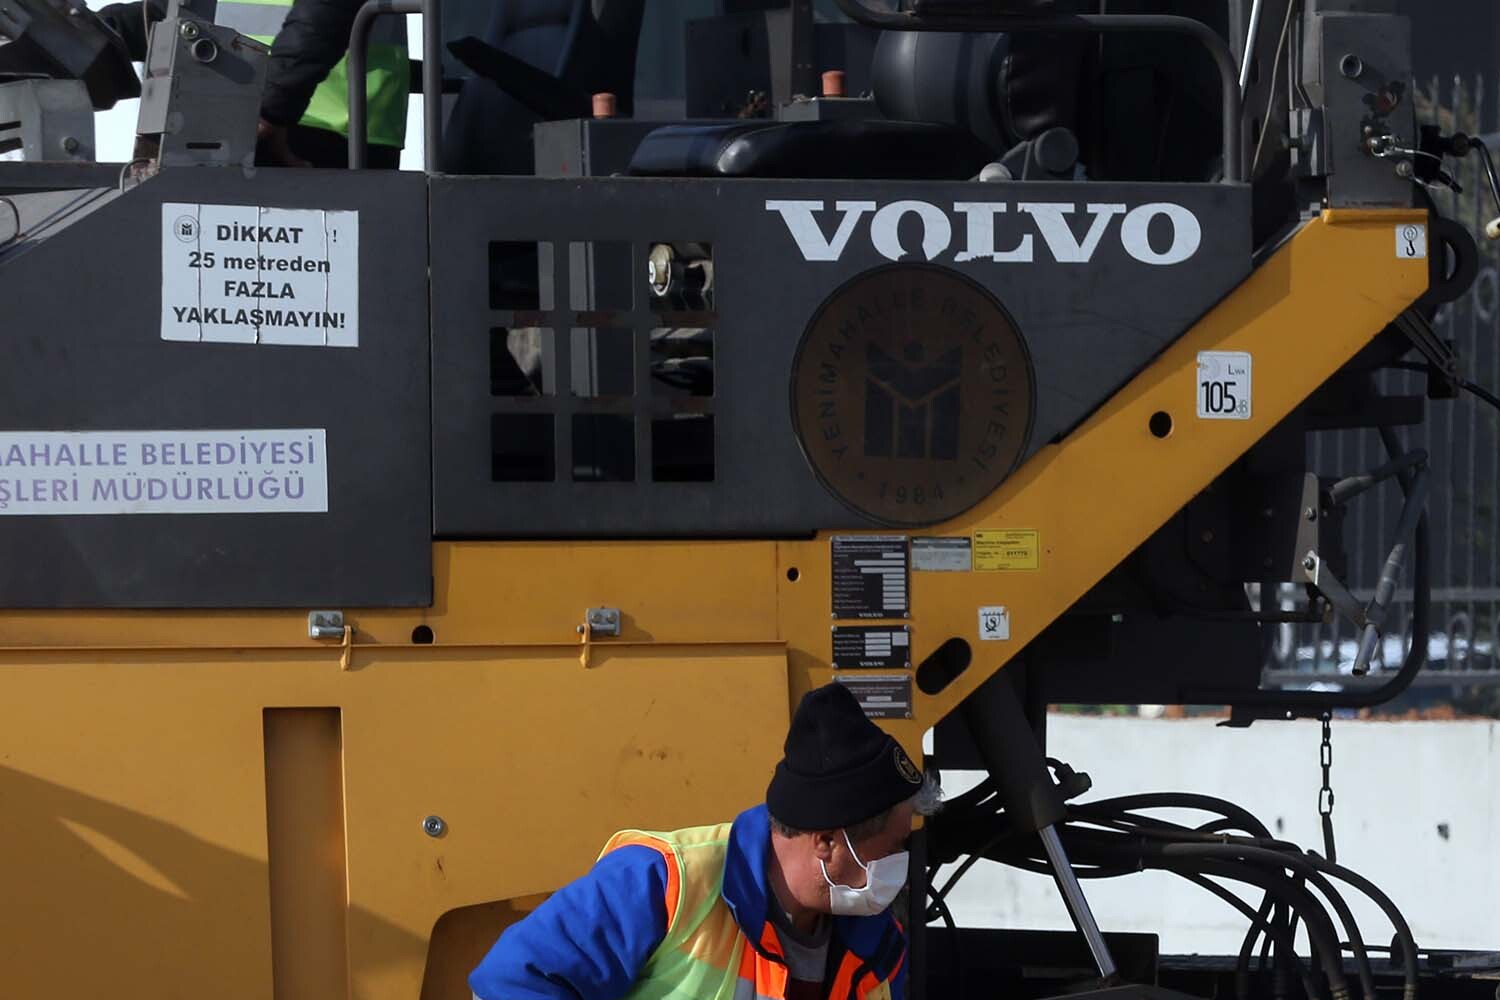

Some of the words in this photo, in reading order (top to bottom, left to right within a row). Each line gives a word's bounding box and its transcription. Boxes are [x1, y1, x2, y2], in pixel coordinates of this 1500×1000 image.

[216, 221, 303, 244] DİKKAT
[765, 200, 1202, 265] VOLVO
[188, 251, 216, 269] 25
[223, 256, 331, 273] metreden
[224, 280, 296, 299] FAZLA
[173, 306, 346, 329] YAKLAŞMAYIN!
[1201, 381, 1236, 413] 105
[141, 434, 314, 466] BELEDİYESİ
[92, 470, 304, 501] MÜDÜRLÜĞÜ
